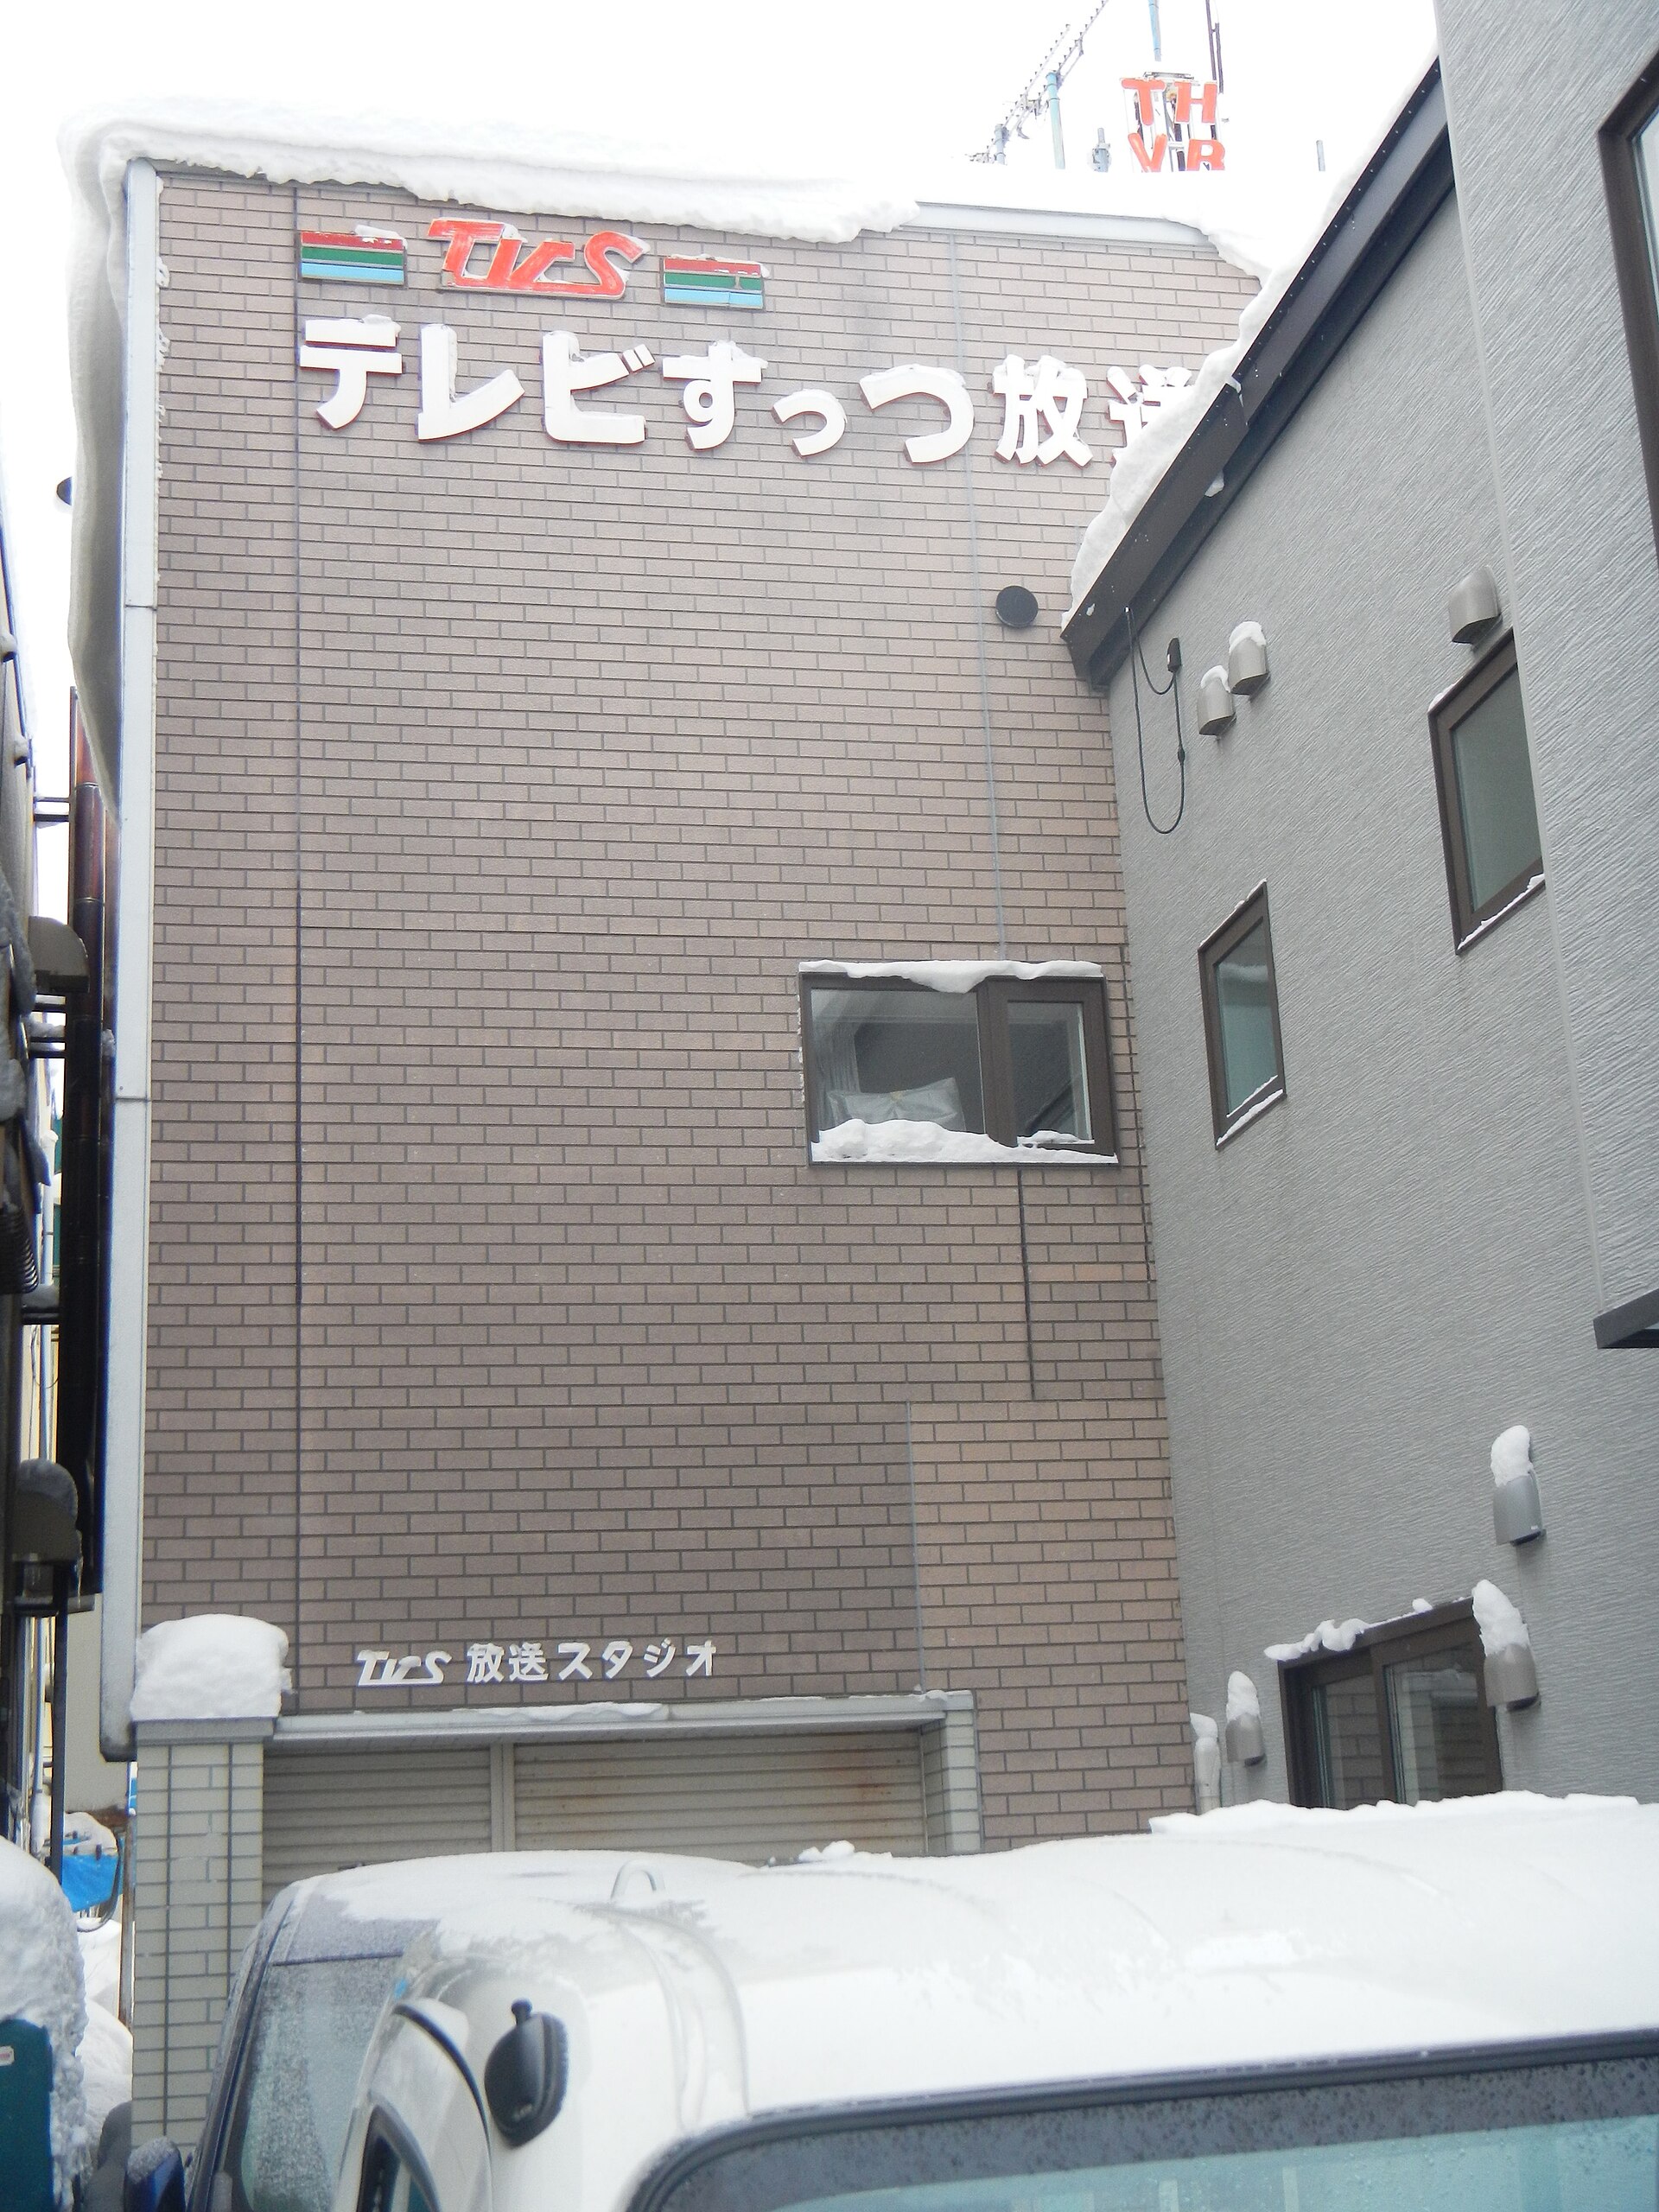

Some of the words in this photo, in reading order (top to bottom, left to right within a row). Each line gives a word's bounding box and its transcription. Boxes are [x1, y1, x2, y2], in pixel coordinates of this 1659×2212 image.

[467, 1637, 716, 1683] 放送スタジオ
